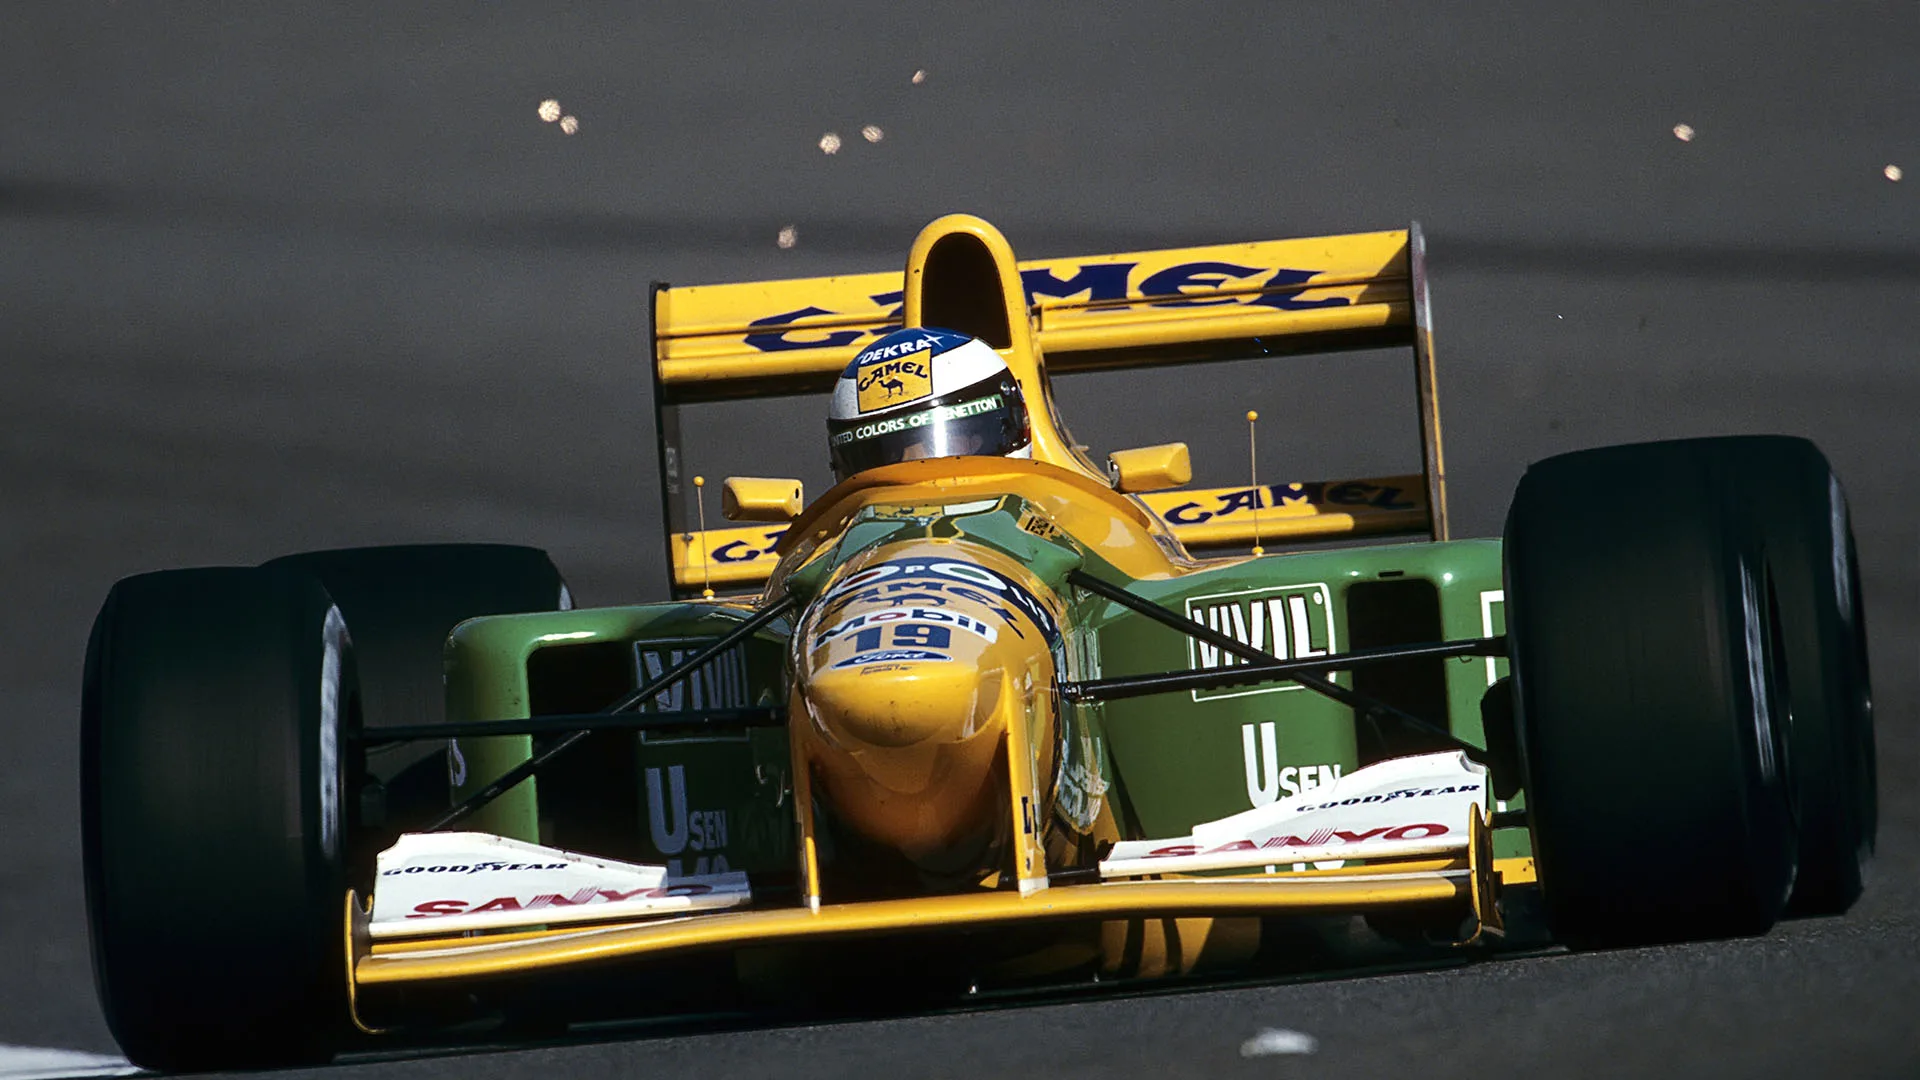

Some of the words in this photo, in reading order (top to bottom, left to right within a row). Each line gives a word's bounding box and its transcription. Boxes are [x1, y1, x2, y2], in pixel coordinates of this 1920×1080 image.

[860, 337, 932, 365] DEKRA
[858, 361, 928, 392] CAMEL
[832, 431, 853, 447] NITED
[856, 418, 905, 439] COLORS
[909, 413, 930, 427] OF
[816, 609, 986, 648] Mobil
[844, 624, 951, 653] 19
[1297, 785, 1480, 812] GOODYEAR
[1140, 824, 1450, 860] SANYO
[383, 861, 569, 876] GOODYEAR
[405, 885, 713, 920] SANYO
